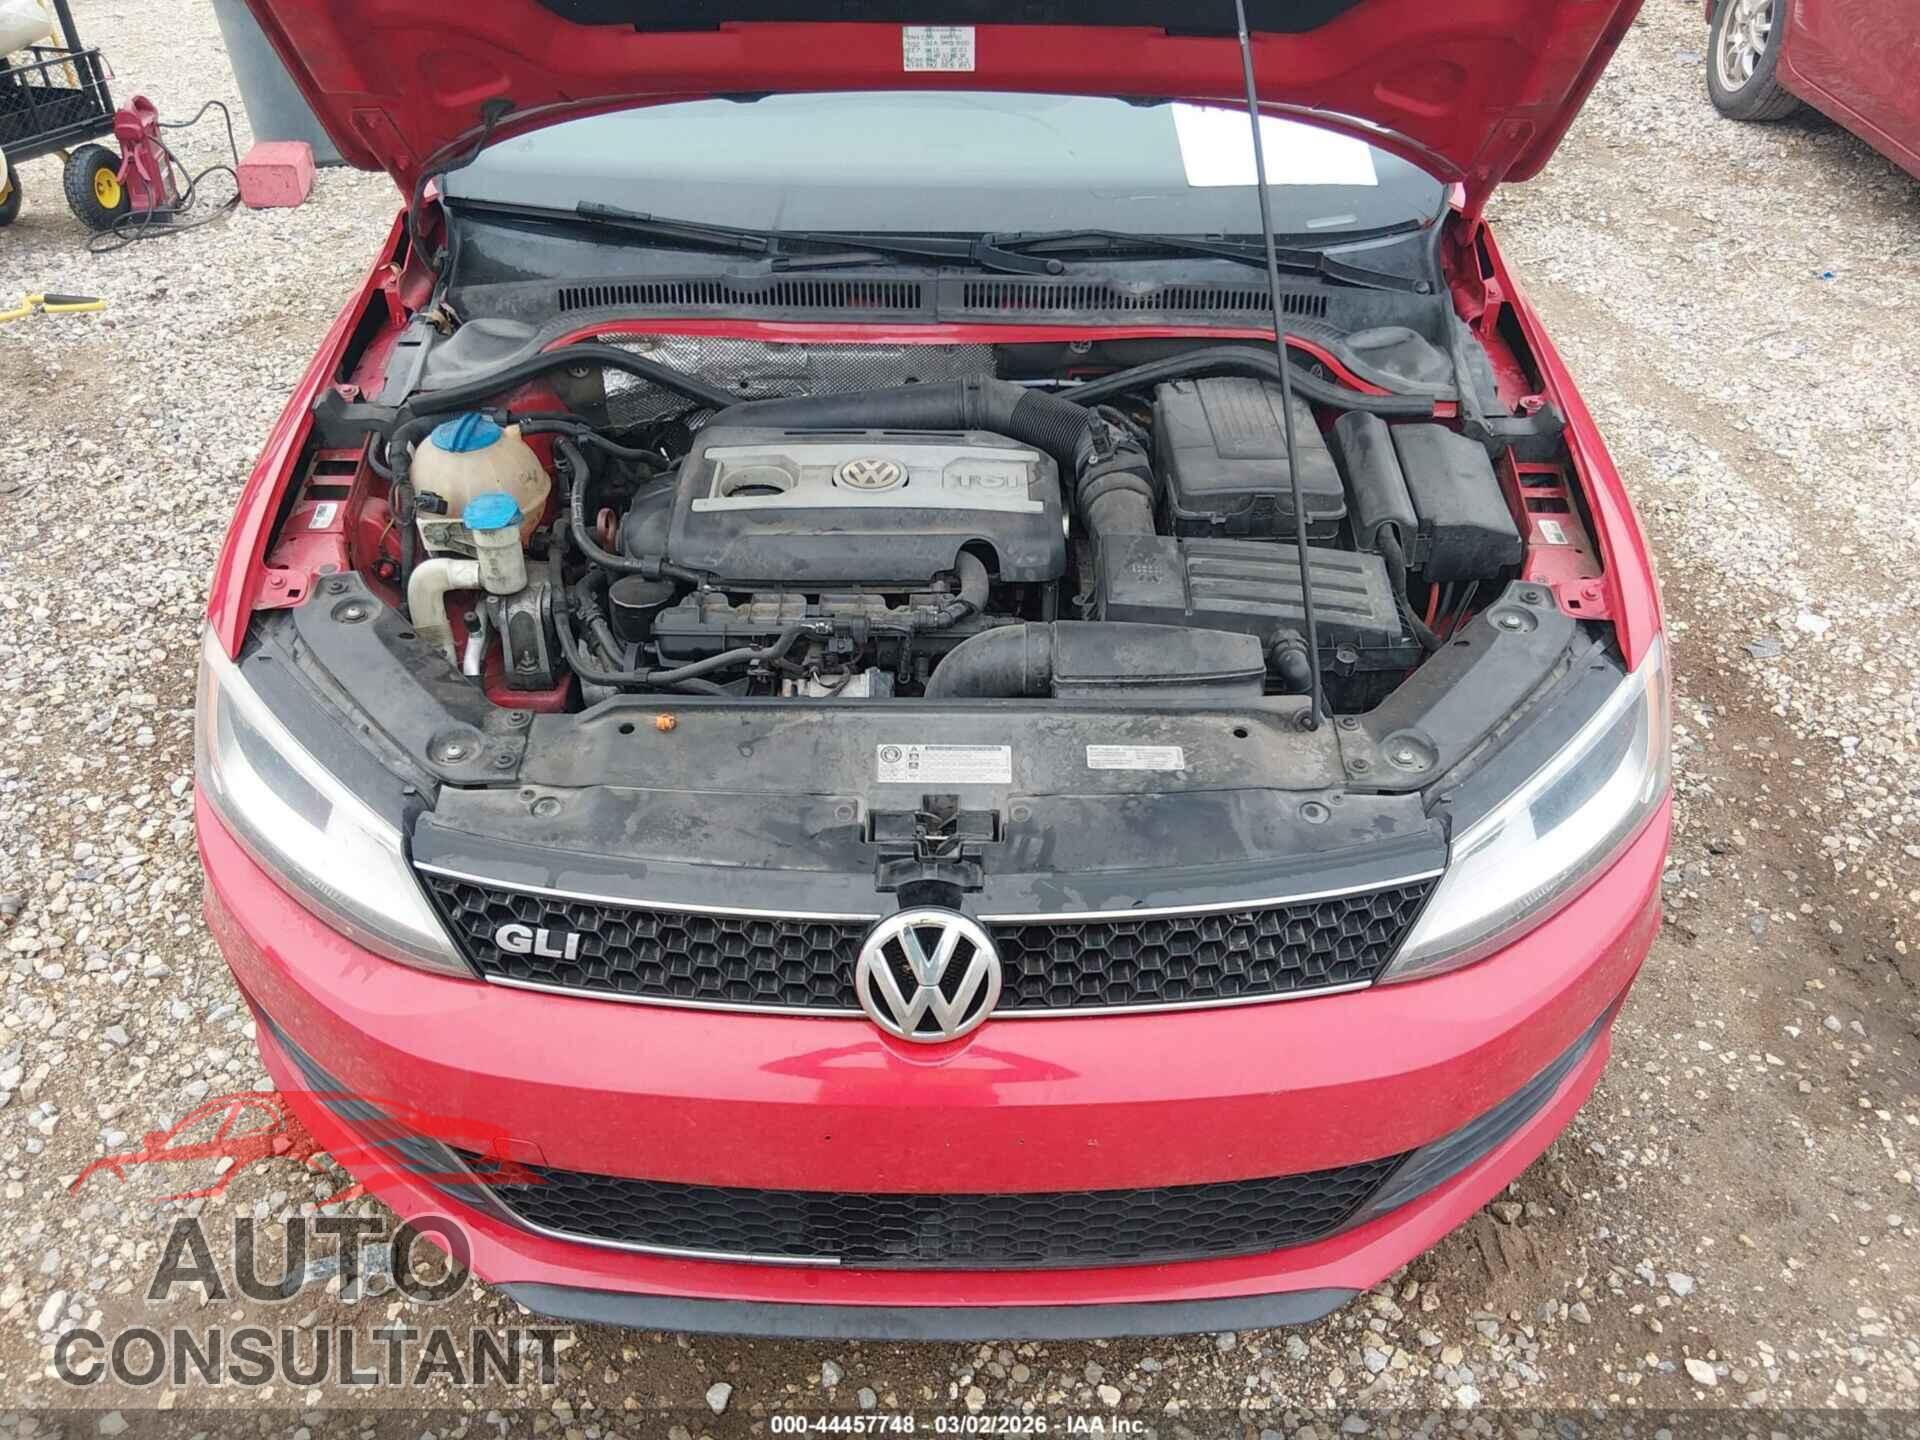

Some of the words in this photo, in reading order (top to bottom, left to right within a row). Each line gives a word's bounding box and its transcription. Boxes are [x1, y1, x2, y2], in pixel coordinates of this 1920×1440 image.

[841, 458, 901, 489] VW
[495, 923, 580, 960] GLI
[857, 911, 1001, 1042] VW
